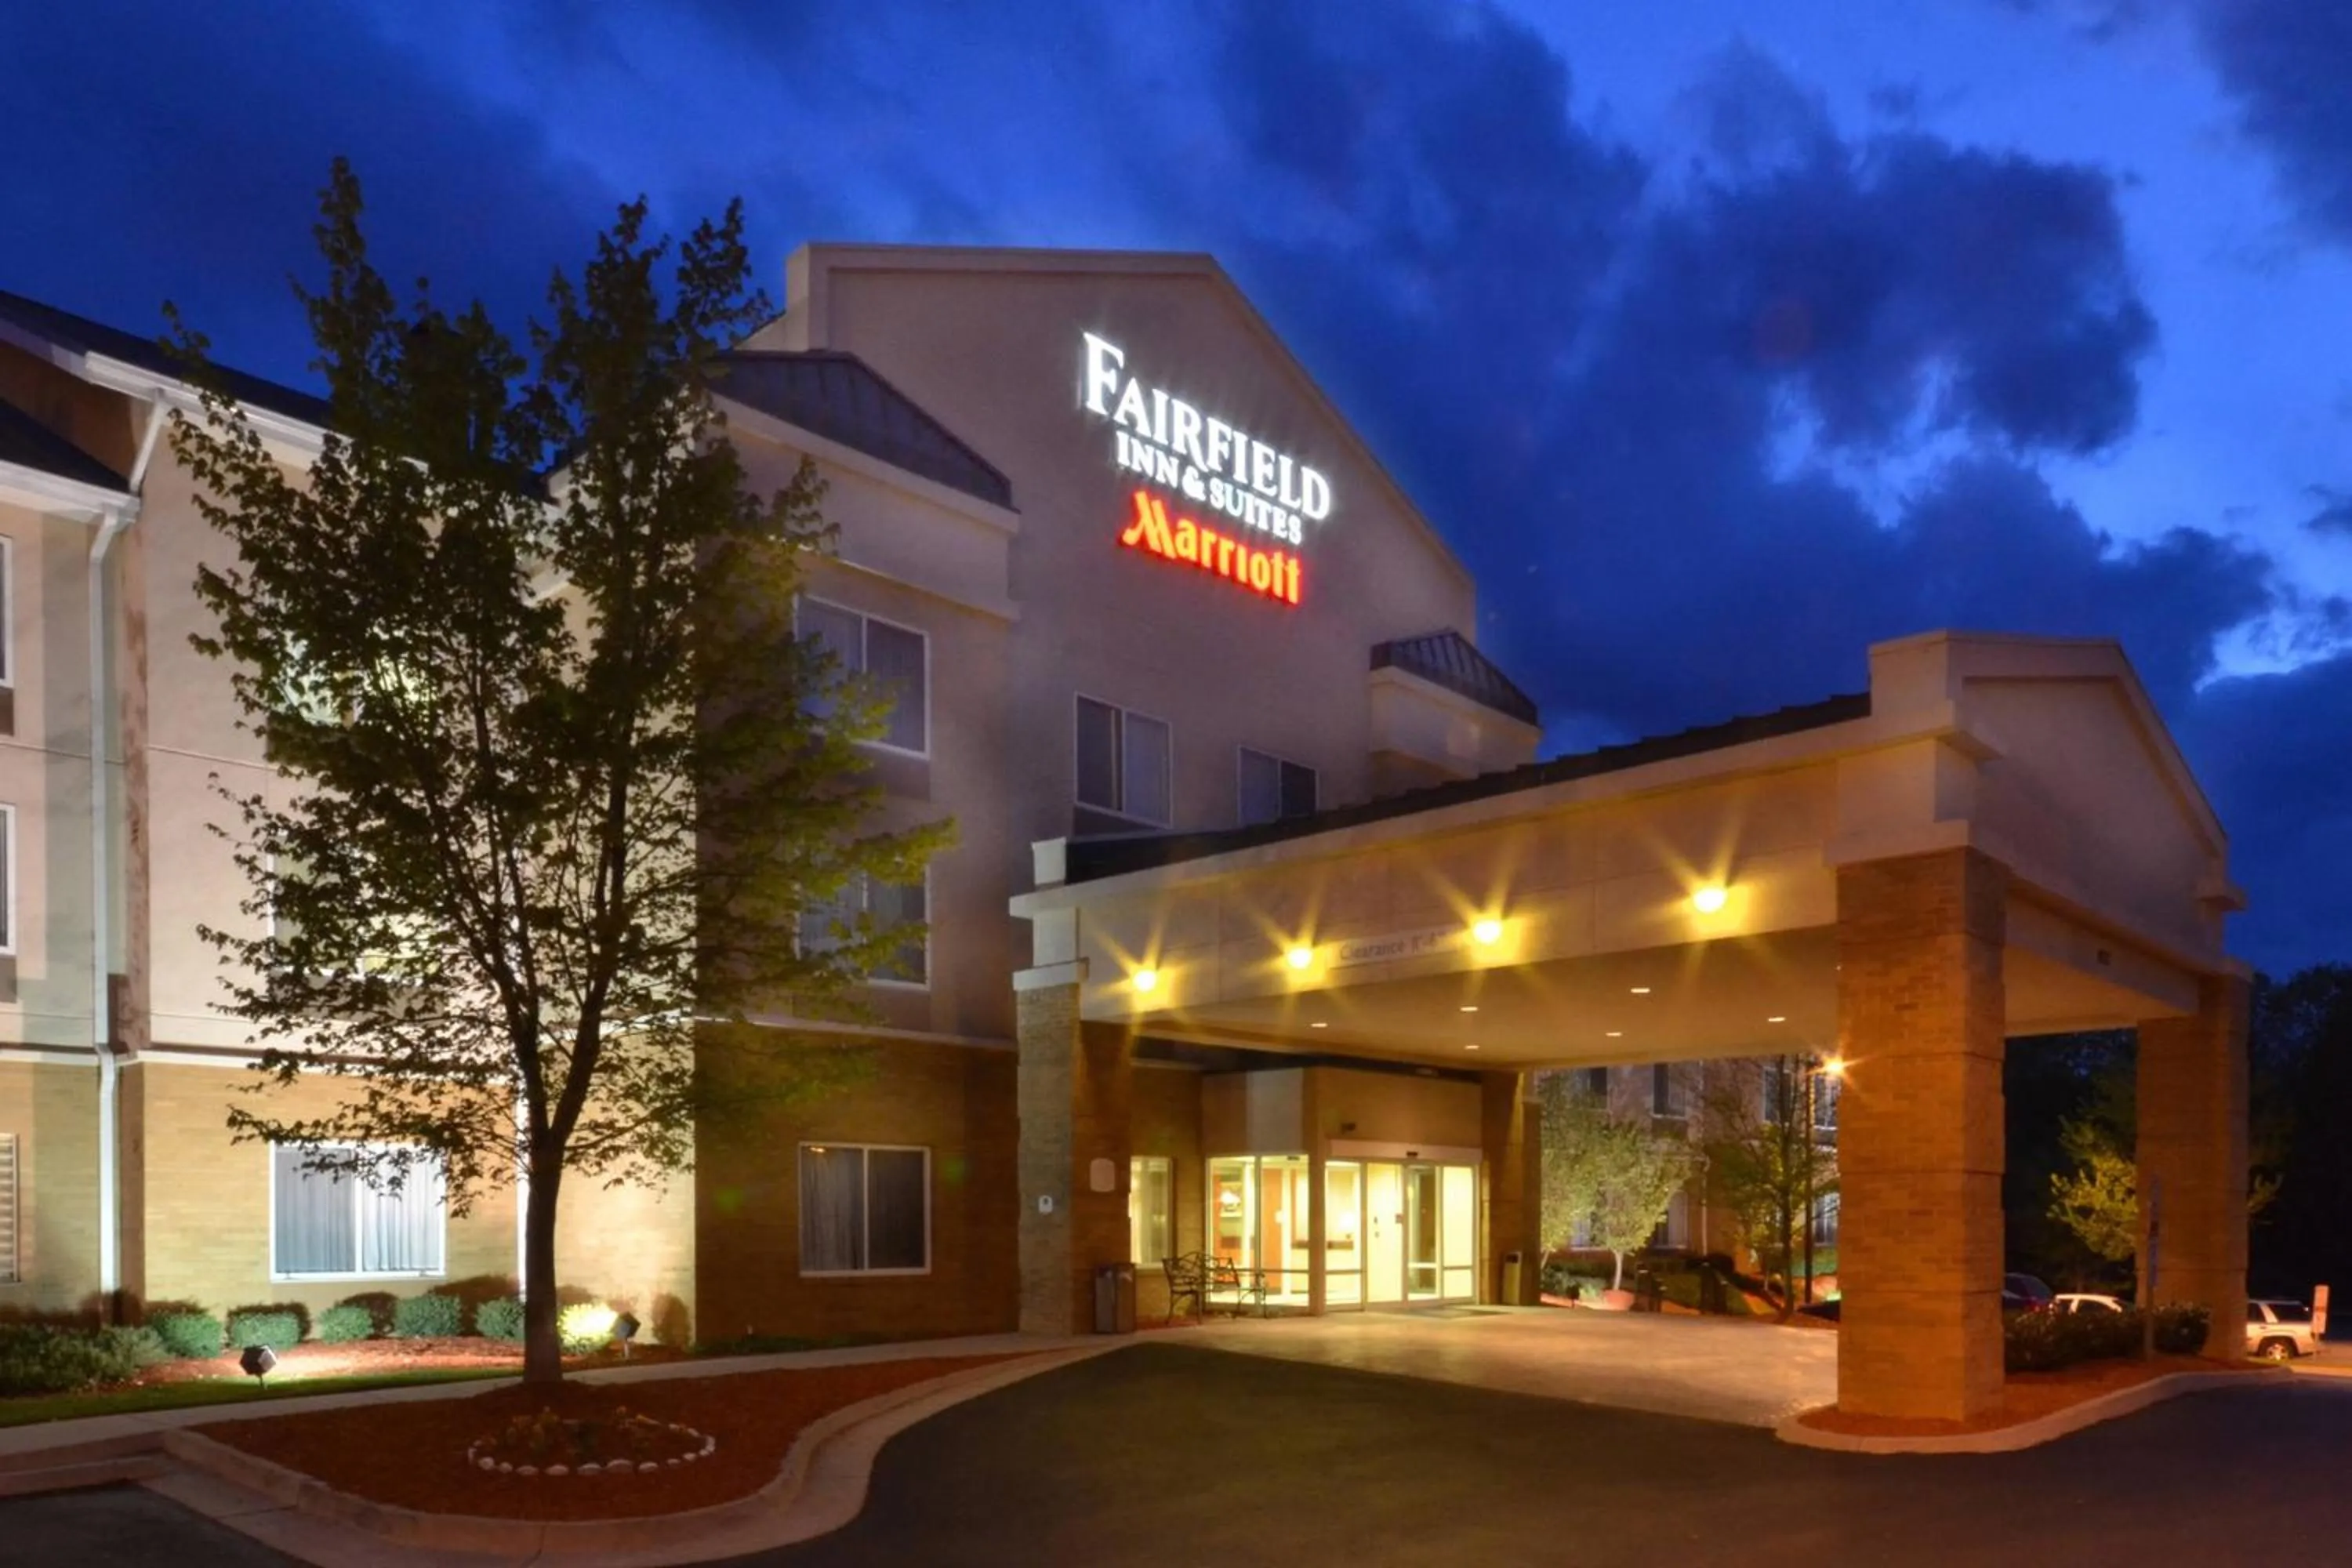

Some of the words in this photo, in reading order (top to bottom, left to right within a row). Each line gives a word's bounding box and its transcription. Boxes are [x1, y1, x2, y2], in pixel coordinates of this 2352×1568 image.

[1083, 331, 1332, 521] FAIRFIELD
[1116, 431, 1178, 488] INN
[1181, 466, 1207, 502] &
[1210, 477, 1303, 546] SUITES
[1122, 491, 1301, 604] Marriott
